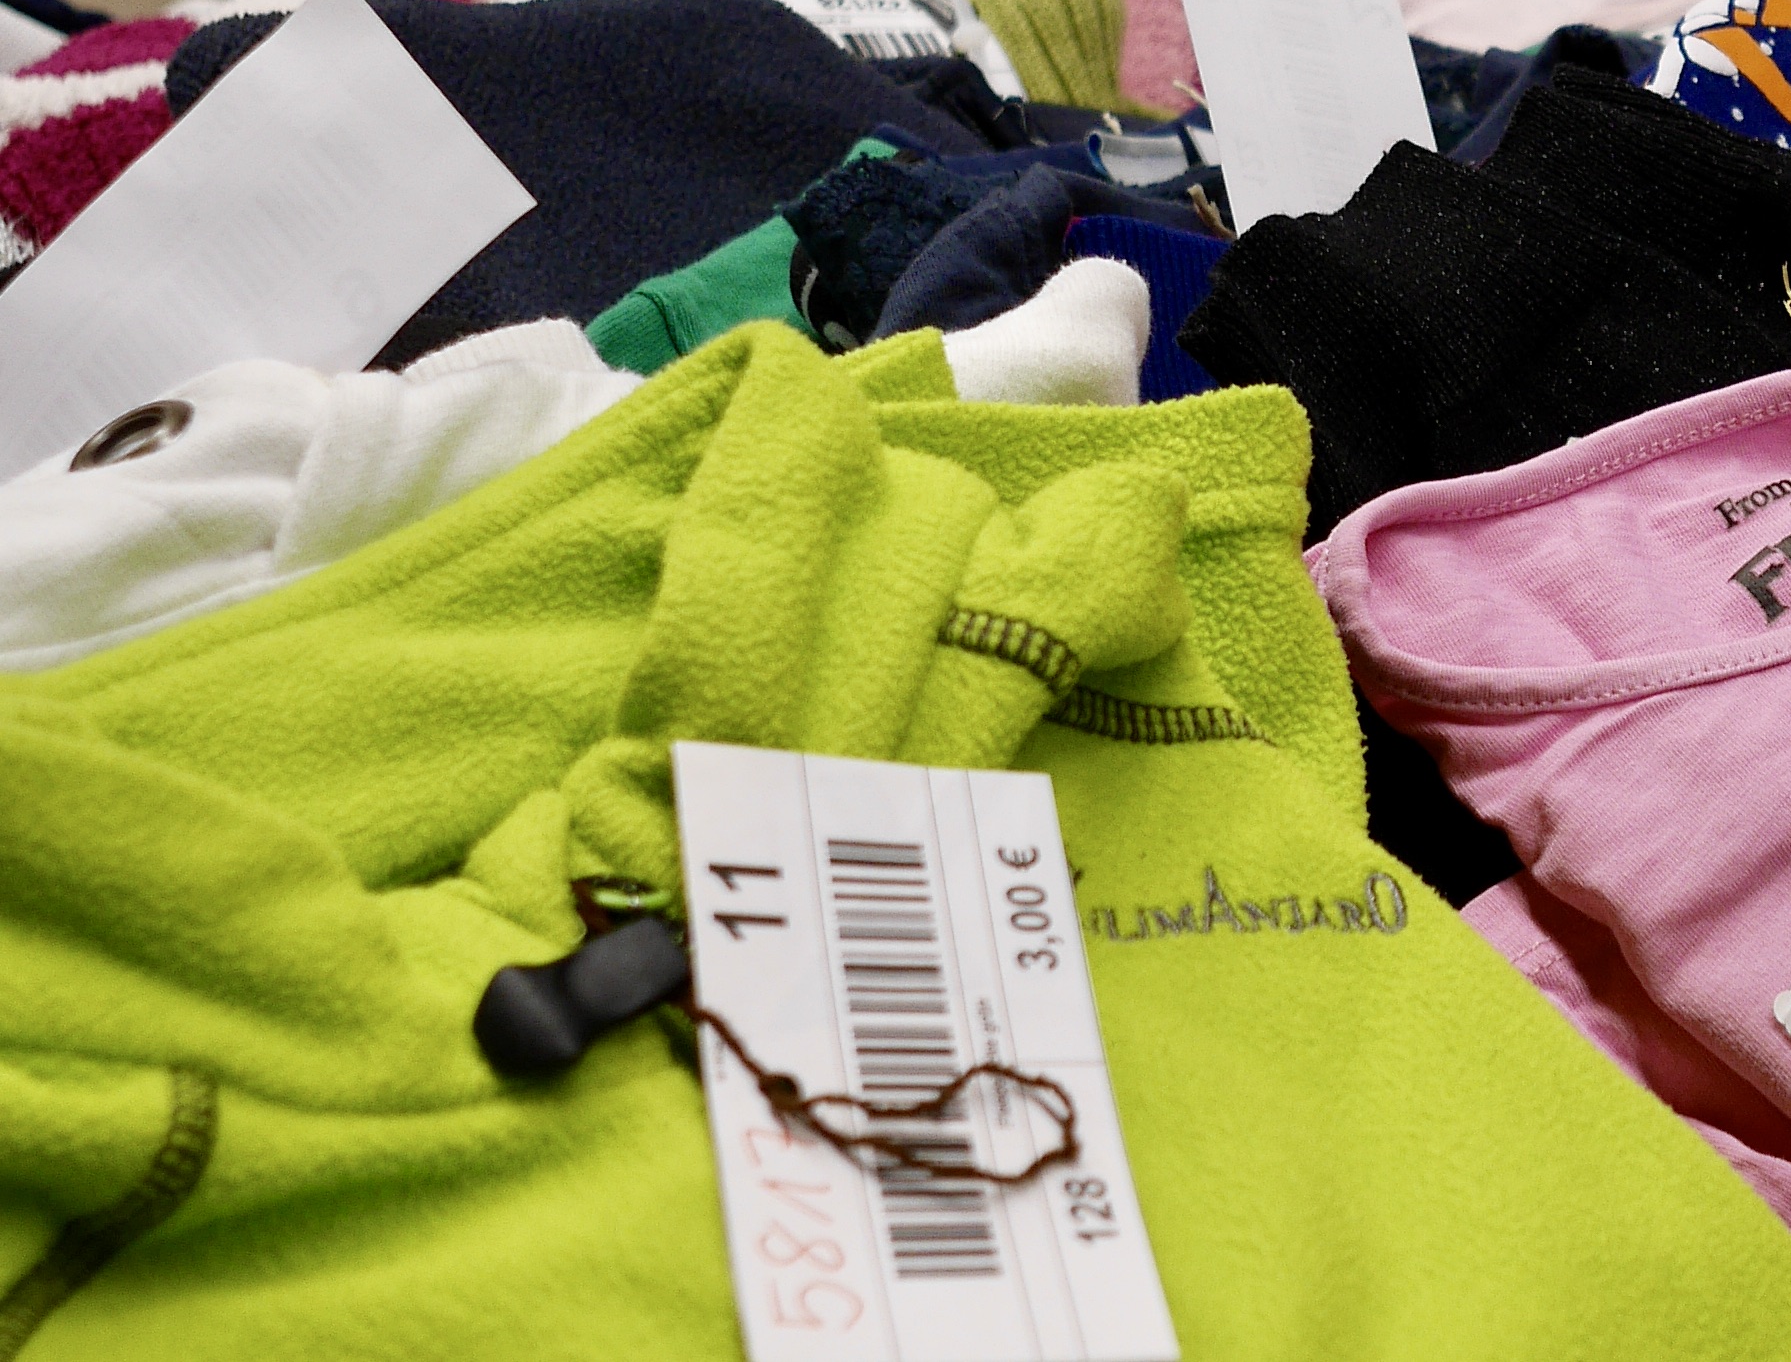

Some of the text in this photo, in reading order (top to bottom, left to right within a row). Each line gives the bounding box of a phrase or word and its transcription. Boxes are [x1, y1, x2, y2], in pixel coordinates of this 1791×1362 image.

[707, 861, 788, 940] 11
[996, 845, 1064, 971] 3,00 €
[743, 1125, 865, 1334] 5817
[1063, 1175, 1119, 1245] 128
